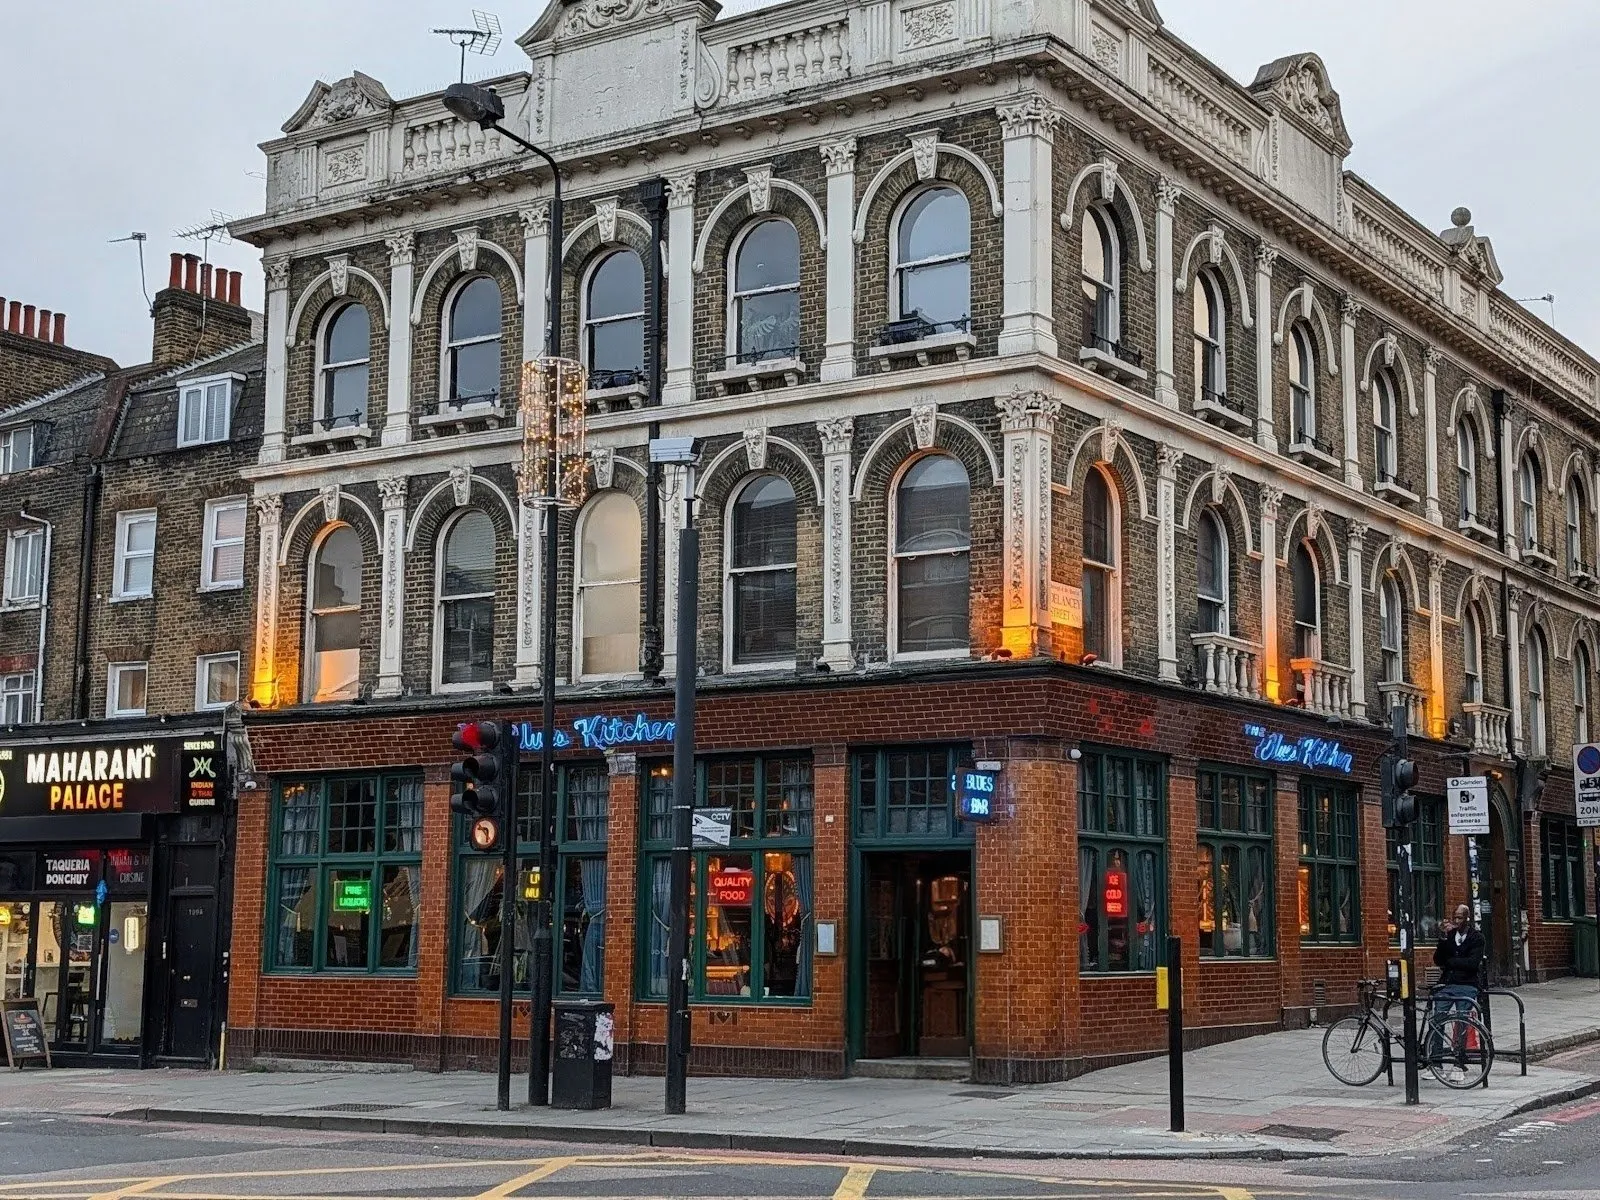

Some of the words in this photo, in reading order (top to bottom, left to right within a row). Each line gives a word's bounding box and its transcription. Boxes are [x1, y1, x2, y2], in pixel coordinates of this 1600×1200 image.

[191, 781, 213, 789] INDIAN
[966, 774, 994, 792] BLUES
[50, 782, 124, 811] PALACE
[189, 798, 215, 806] CUISINE
[711, 812, 731, 821] CCTV
[46, 859, 90, 872] TAQUERIA
[46, 874, 65, 885] DON
[65, 873, 89, 885] CHUY
[714, 876, 752, 887] QUALITY
[719, 890, 746, 901] FOOD
